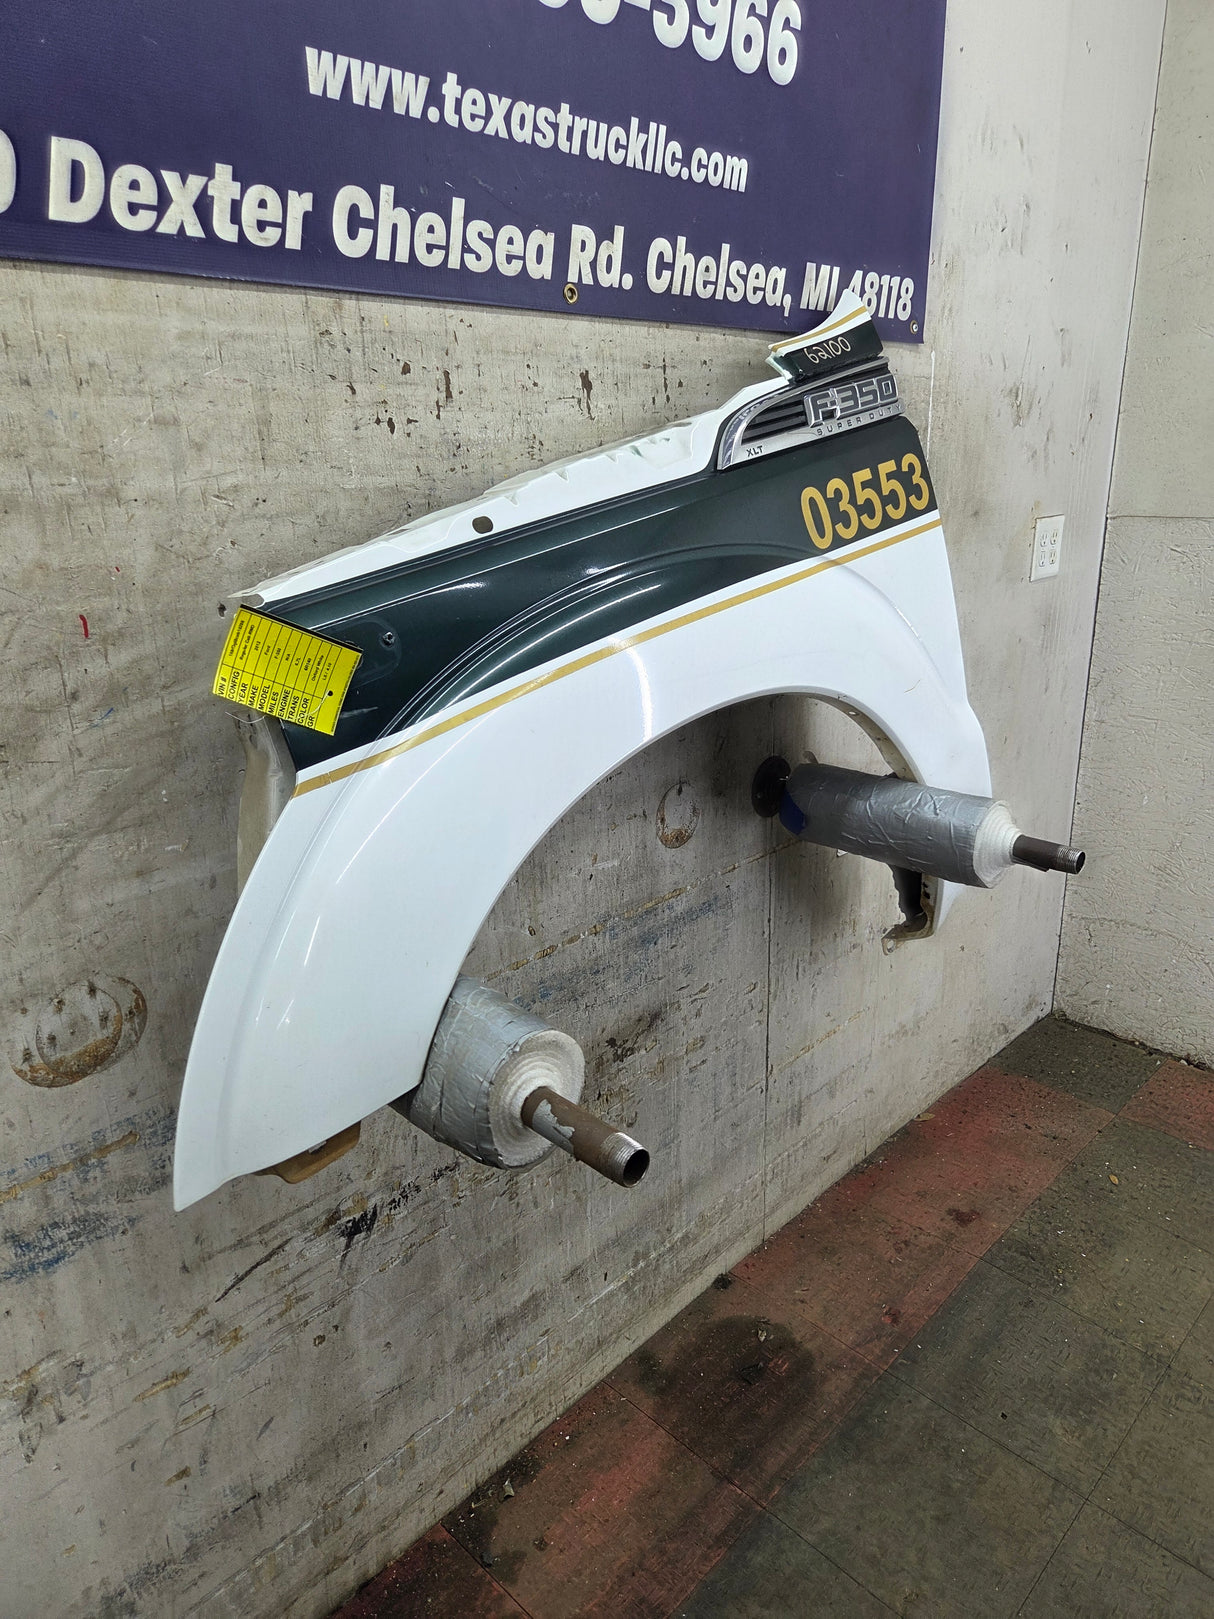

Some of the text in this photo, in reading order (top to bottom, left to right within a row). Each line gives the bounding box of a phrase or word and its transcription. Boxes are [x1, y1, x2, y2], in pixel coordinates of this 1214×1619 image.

[305, 46, 748, 193] www.texastruckllc.com
[49, 136, 313, 250] Dexter
[332, 184, 555, 280] Chelsea
[567, 224, 633, 290] Rd.
[646, 236, 792, 317] Chelsea,
[800, 262, 840, 311] MI
[847, 270, 914, 321] 48118
[804, 336, 851, 364] 62100
[816, 404, 901, 436] SUPER DUTY
[746, 445, 764, 457] XLT
[801, 453, 929, 549] 03553
[228, 671, 240, 699] CONFIG
[238, 683, 248, 702] YEAR
[248, 685, 259, 707] MAKE
[258, 685, 270, 710] MODEL
[268, 691, 279, 714] MILES
[278, 689, 290, 717] ENGINE
[287, 695, 299, 719] TRANS
[297, 697, 310, 724] COLOR
[307, 716, 315, 727] GR
